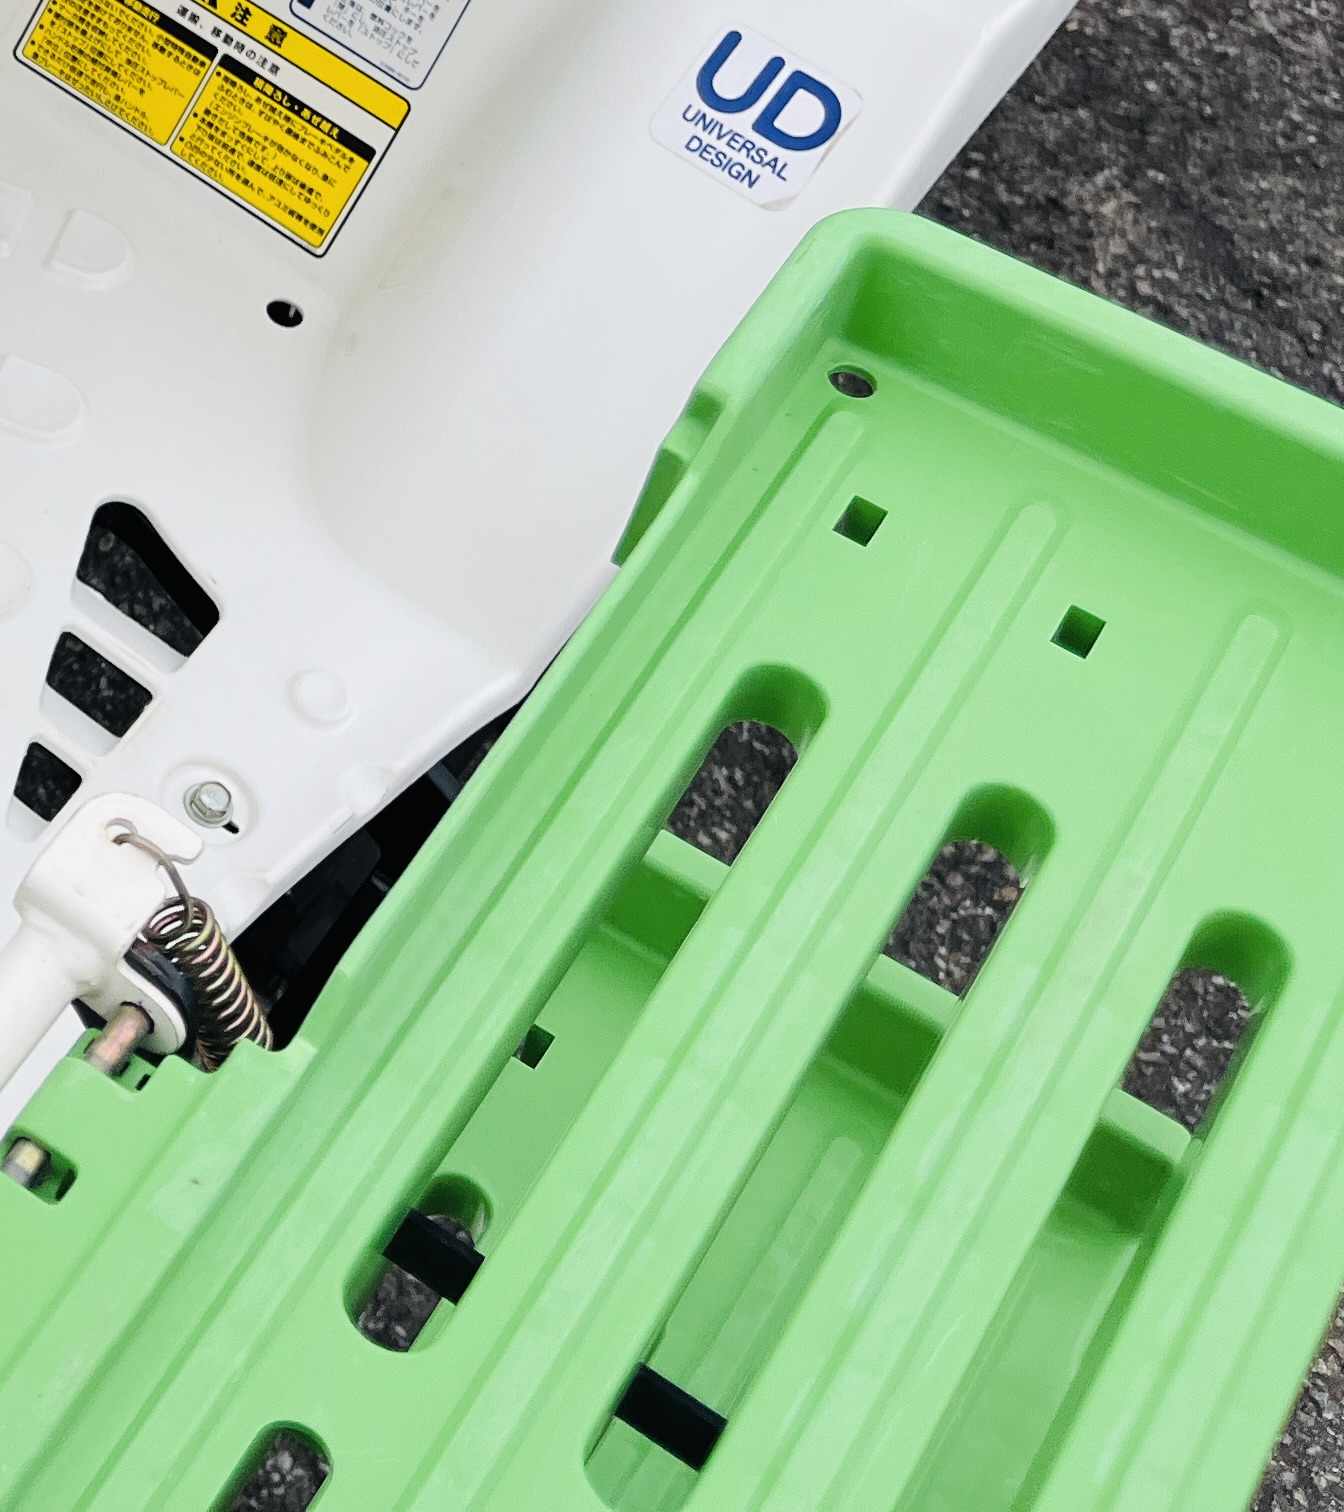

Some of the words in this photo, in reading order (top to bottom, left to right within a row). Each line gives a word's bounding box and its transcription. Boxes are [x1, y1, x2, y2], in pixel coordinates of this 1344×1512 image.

[228, 1, 290, 50] 注意
[696, 30, 842, 152] UD
[682, 104, 788, 182] UNIVERSAL
[684, 135, 761, 189] DESIGN
